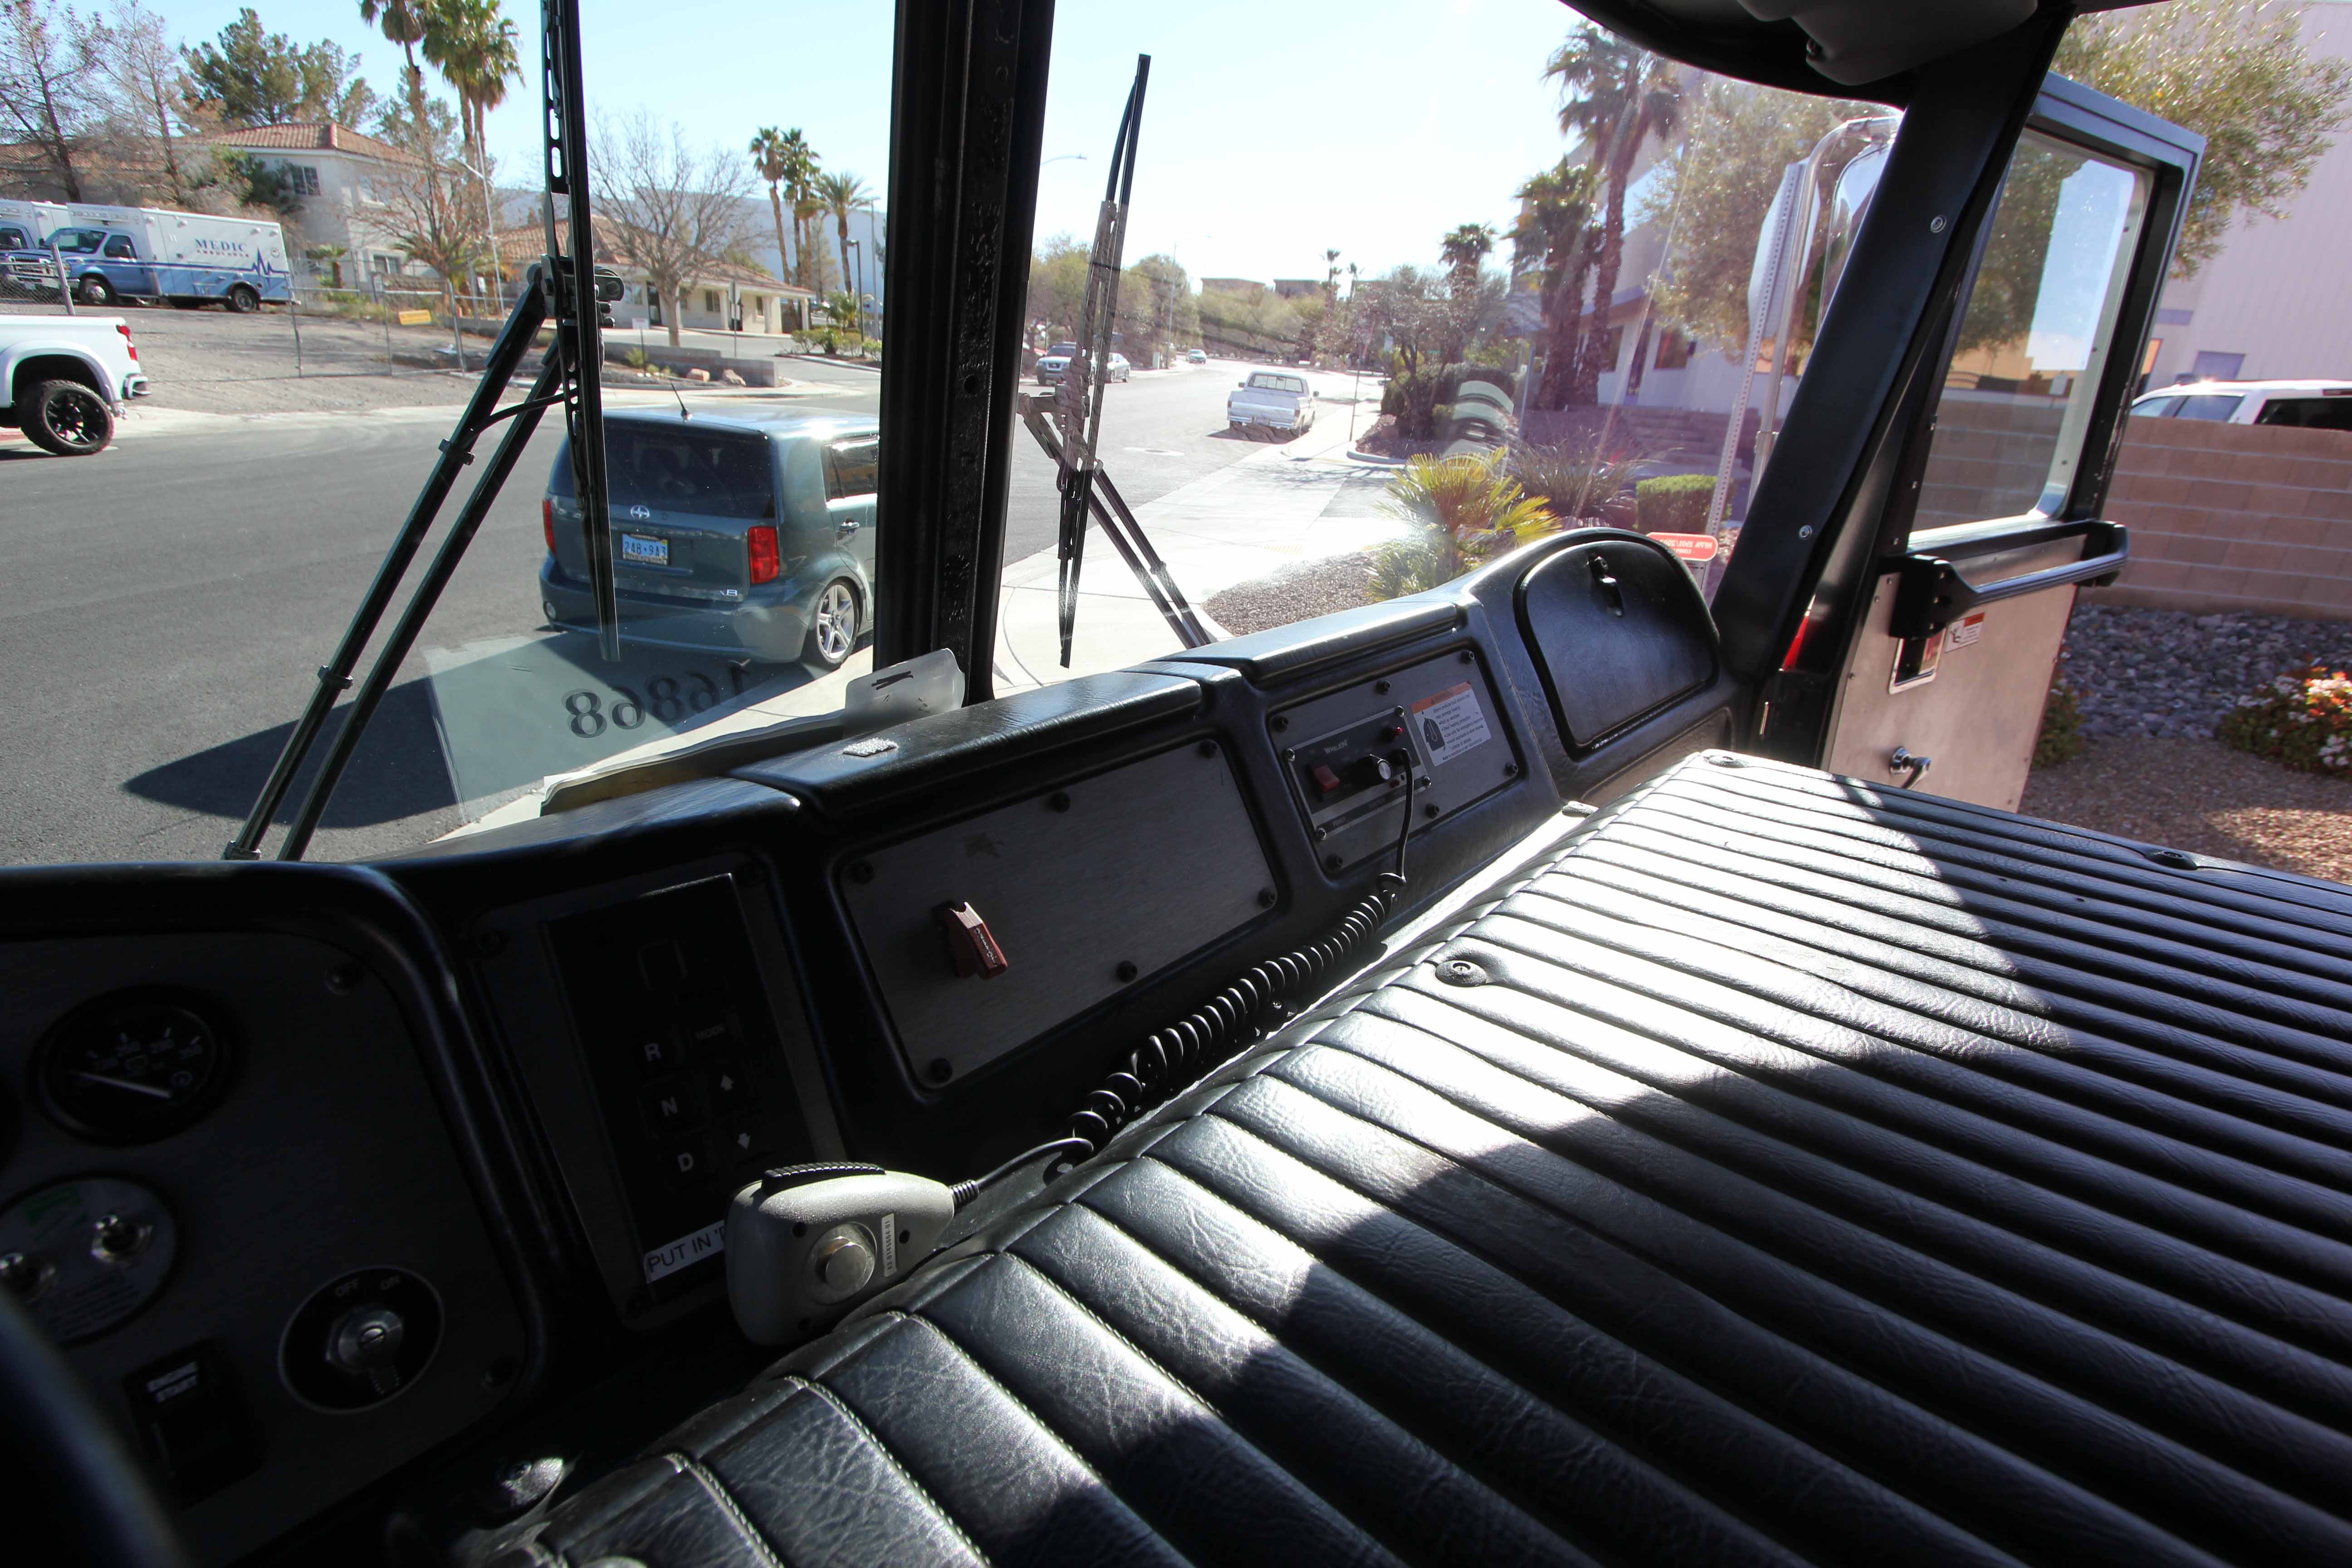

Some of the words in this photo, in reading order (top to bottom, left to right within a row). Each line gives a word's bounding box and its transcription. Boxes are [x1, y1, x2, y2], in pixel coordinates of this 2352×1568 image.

[195, 239, 247, 252] MEDIC
[644, 1042, 662, 1062] R
[661, 1096, 679, 1118] N
[677, 1152, 694, 1173] D
[647, 1243, 686, 1273] PUT
[692, 1233, 711, 1254] IN
[334, 1277, 360, 1298] OFF
